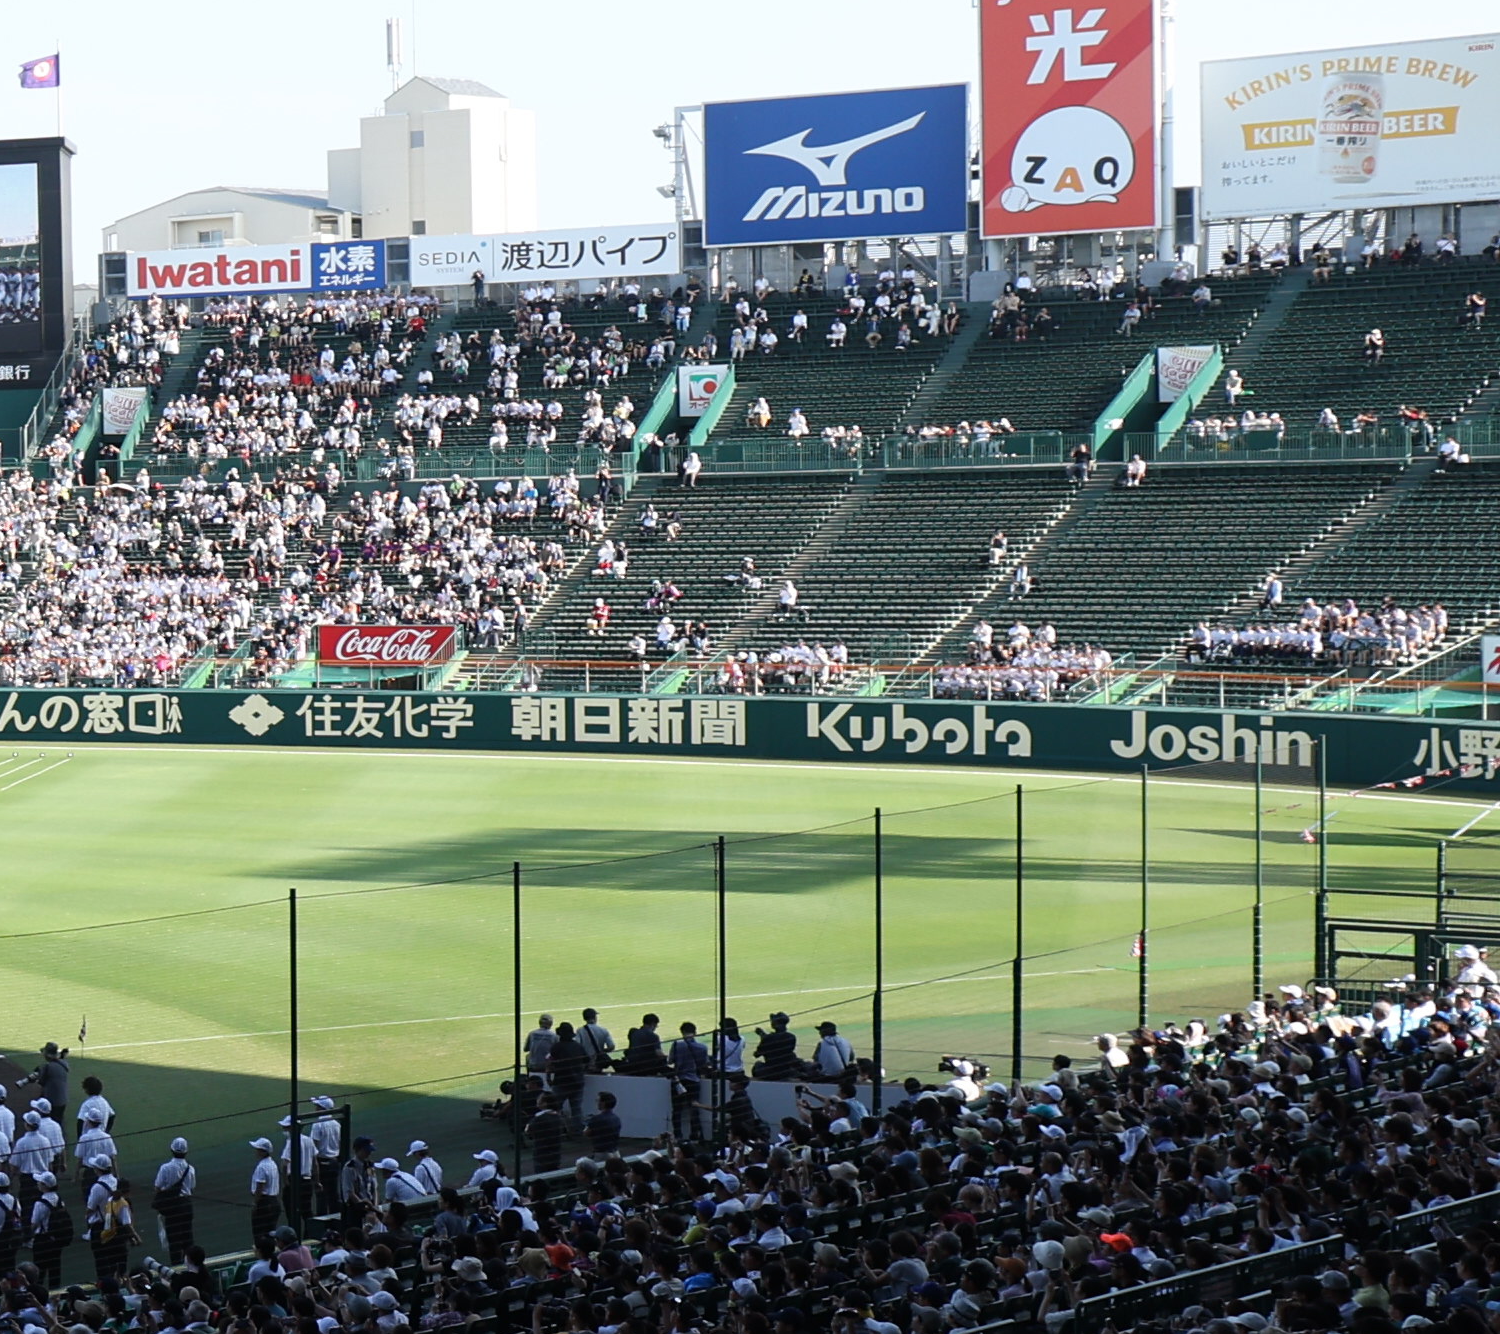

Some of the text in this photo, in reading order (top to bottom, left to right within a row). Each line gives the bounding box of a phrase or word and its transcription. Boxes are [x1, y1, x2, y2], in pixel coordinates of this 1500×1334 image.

[1025, 8, 1118, 85] 光
[1468, 43, 1495, 53] KIRIN
[1223, 63, 1313, 111] KIRIN'S
[1322, 55, 1400, 78] PRIME
[1404, 57, 1479, 89] BREW
[1383, 113, 1446, 135] BEER
[1221, 155, 1297, 170] おいしいとこだけ
[136, 249, 301, 290] Iwatani
[319, 245, 376, 273] 水素
[418, 251, 481, 266] SEDIA
[501, 231, 677, 271] 渡辺パイプ
[319, 274, 376, 287] エネルギー
[296, 695, 475, 739] 住友化学
[511, 696, 746, 746] 朝日新聞
[807, 702, 1032, 758] Kubota
[1110, 710, 1312, 767] Joshin
